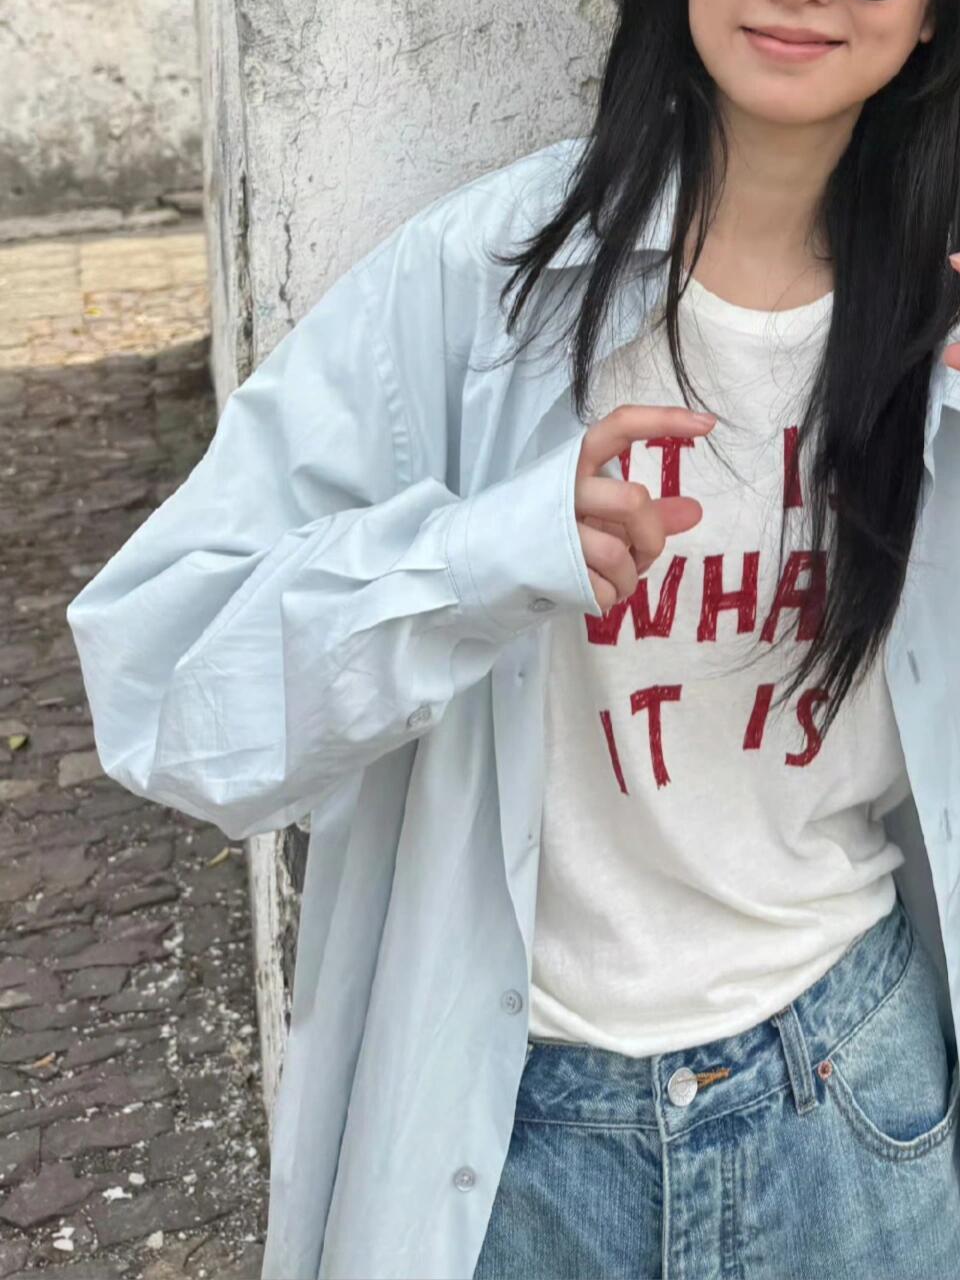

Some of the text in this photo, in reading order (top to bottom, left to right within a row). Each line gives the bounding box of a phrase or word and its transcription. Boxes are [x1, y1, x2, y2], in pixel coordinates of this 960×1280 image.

[584, 550, 830, 647] WHA
[600, 682, 831, 796] IT IS
